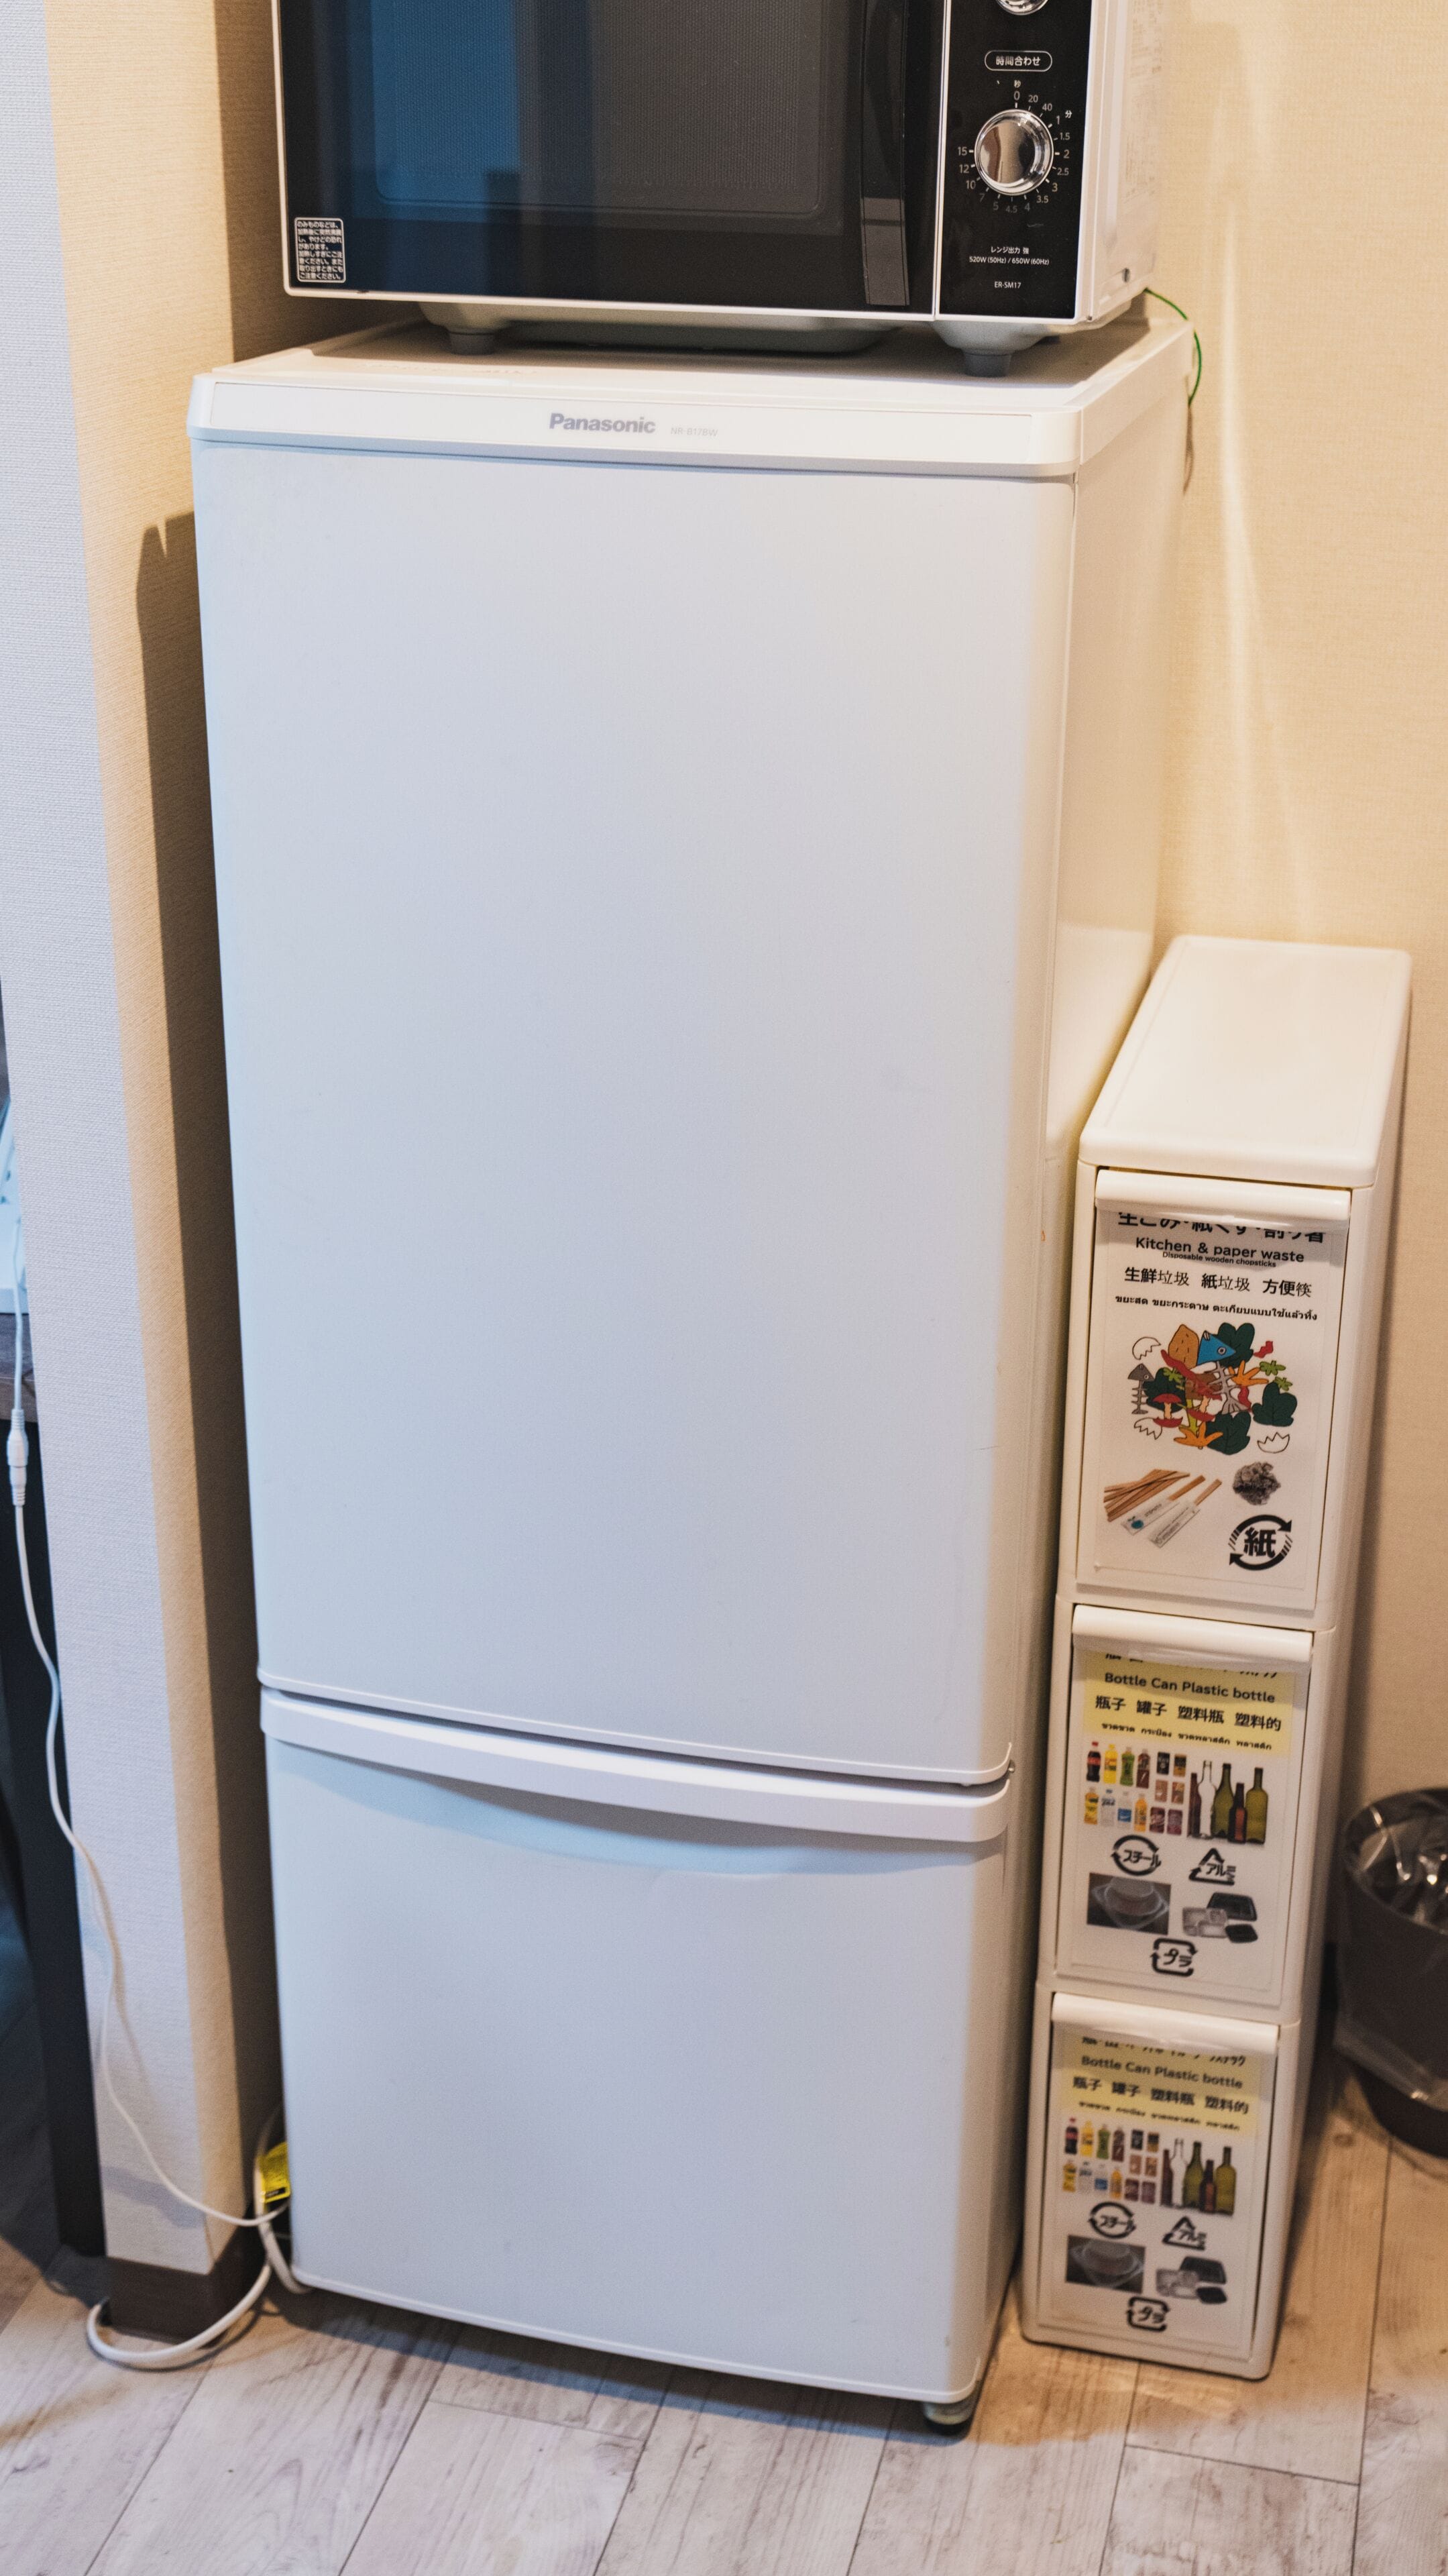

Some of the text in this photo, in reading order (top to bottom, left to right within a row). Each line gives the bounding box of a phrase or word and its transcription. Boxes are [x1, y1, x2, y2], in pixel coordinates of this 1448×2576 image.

[995, 56, 1041, 66] 時間合わせ
[1013, 80, 1021, 88] 秒
[1013, 91, 1020, 101] 0
[1028, 95, 1038, 103] 20
[1042, 103, 1052, 111] 40
[1065, 110, 1072, 118] 分
[1056, 115, 1060, 125] 1
[1060, 132, 1070, 140] 1.5
[958, 146, 967, 156] 15
[1063, 150, 1070, 158] 2
[959, 164, 970, 174] 12
[1057, 168, 1069, 176] 2.5
[966, 180, 977, 189] 10
[1052, 183, 1058, 192] 3
[979, 193, 985, 202] 7
[1036, 195, 1049, 203] 3.5
[993, 202, 999, 211] 5
[1005, 205, 1018, 213] 4.5
[1024, 203, 1031, 211] 4
[991, 246, 1021, 254] レンジ出力
[994, 281, 1021, 289] ER-SM17
[549, 413, 656, 434] Panasonic
[1136, 1237, 1304, 1263] Kitchen & paper waste
[1162, 1252, 1276, 1267] Disposable wooden chopsticks
[1125, 1267, 1312, 1297] 生鮮垃圾 紙垃圾 方便筷
[1243, 1527, 1276, 1559] 紙
[1105, 1672, 1275, 1704] Bottle Can Plastic bottle
[1096, 1695, 1126, 1711] 瓶子
[1178, 1705, 1225, 1725] 塑料瓶
[1235, 1712, 1282, 1732] 塑料的
[1123, 1849, 1162, 1868] スチール
[1205, 1863, 1237, 1879] アルミ
[1163, 1948, 1192, 1968] プラ
[1081, 2055, 1243, 2090] Bottle Can Plastic bottle
